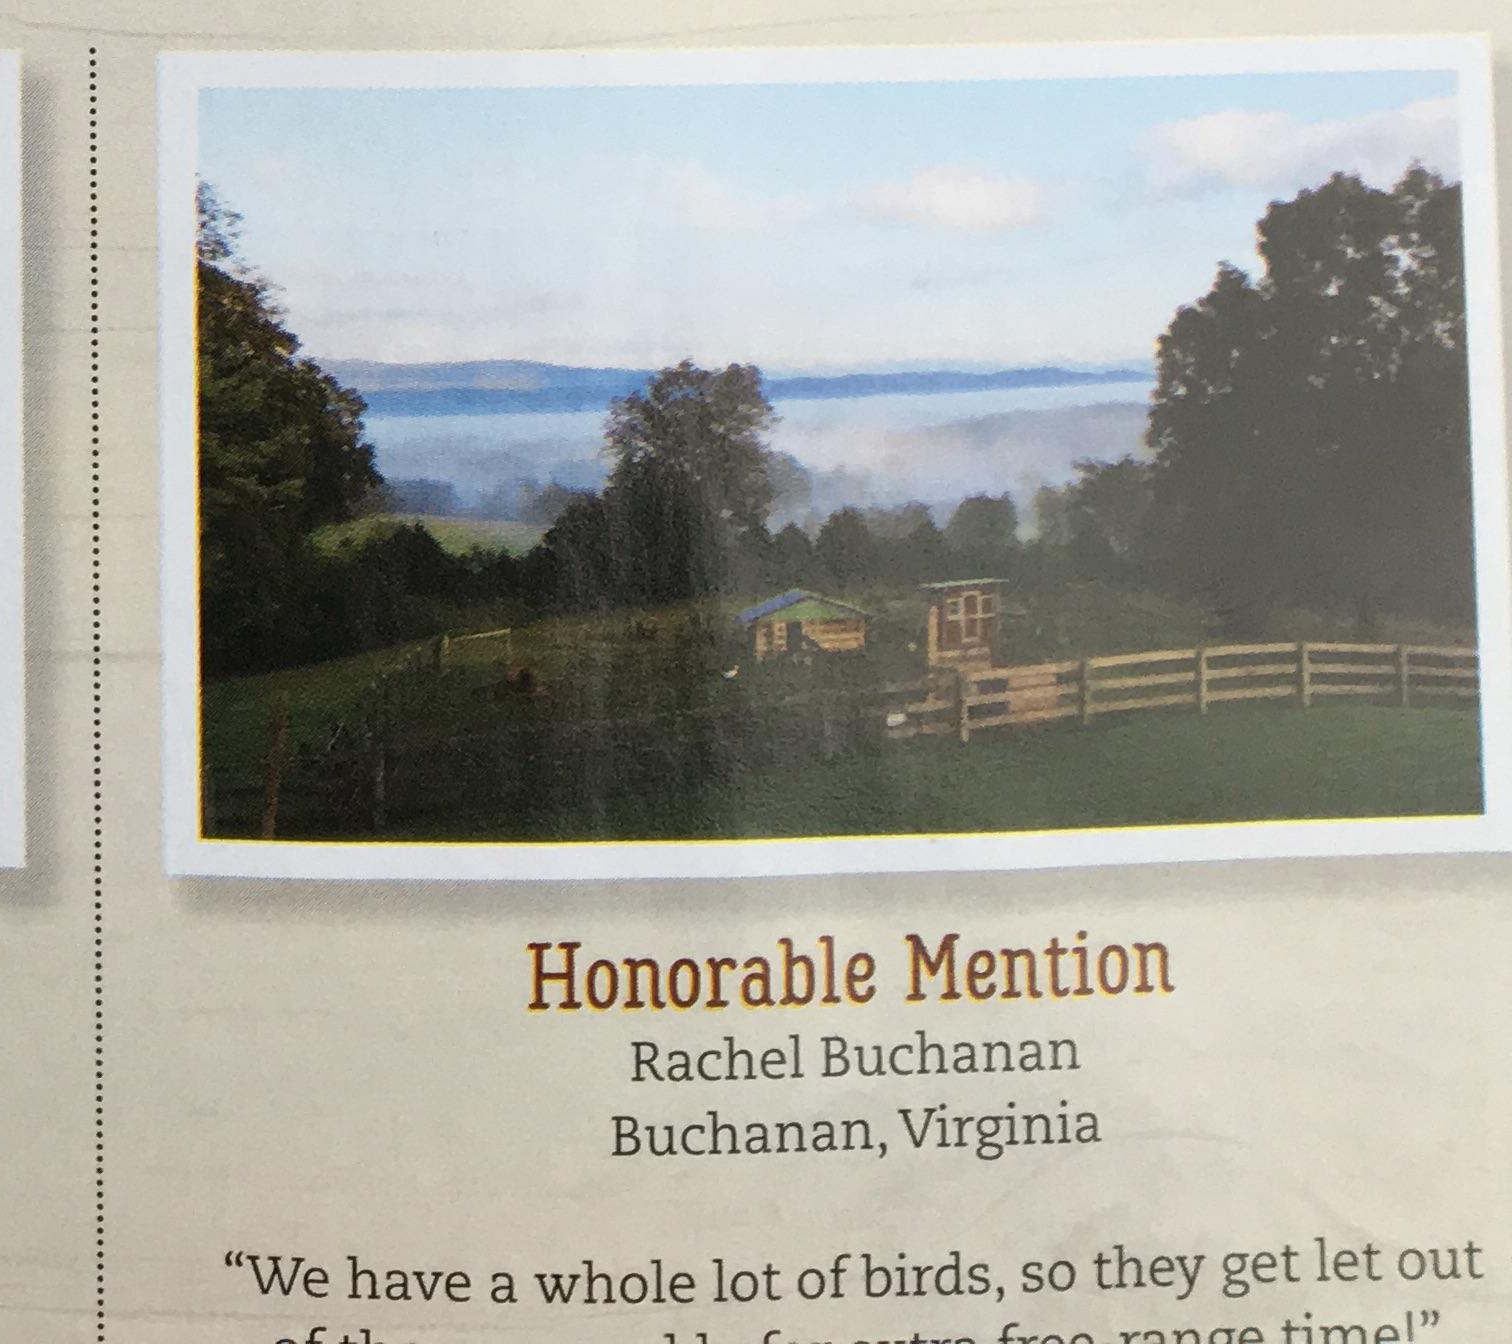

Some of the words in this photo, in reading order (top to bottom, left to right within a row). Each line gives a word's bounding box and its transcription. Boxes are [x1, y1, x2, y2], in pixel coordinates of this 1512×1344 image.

[527, 935, 876, 1010] Honorable
[905, 930, 1175, 1001] Mention
[631, 1034, 804, 1082] Rachel
[821, 1030, 1081, 1077] Buchanan
[611, 1111, 887, 1159] Buchanan,
[897, 1099, 1102, 1161] Virginia
[224, 1251, 329, 1298] “We
[346, 1255, 471, 1302] have
[491, 1272, 518, 1303] a
[534, 1259, 695, 1304] whole
[712, 1258, 782, 1302] lot
[798, 1253, 851, 1300] of
[861, 1251, 1004, 1303] birds,
[1022, 1260, 1076, 1293] so
[1093, 1244, 1206, 1300] they
[1222, 1245, 1300, 1298] get
[1314, 1237, 1382, 1281] let
[1398, 1241, 1484, 1280] out
[1280, 1310, 1441, 1344] time!”
